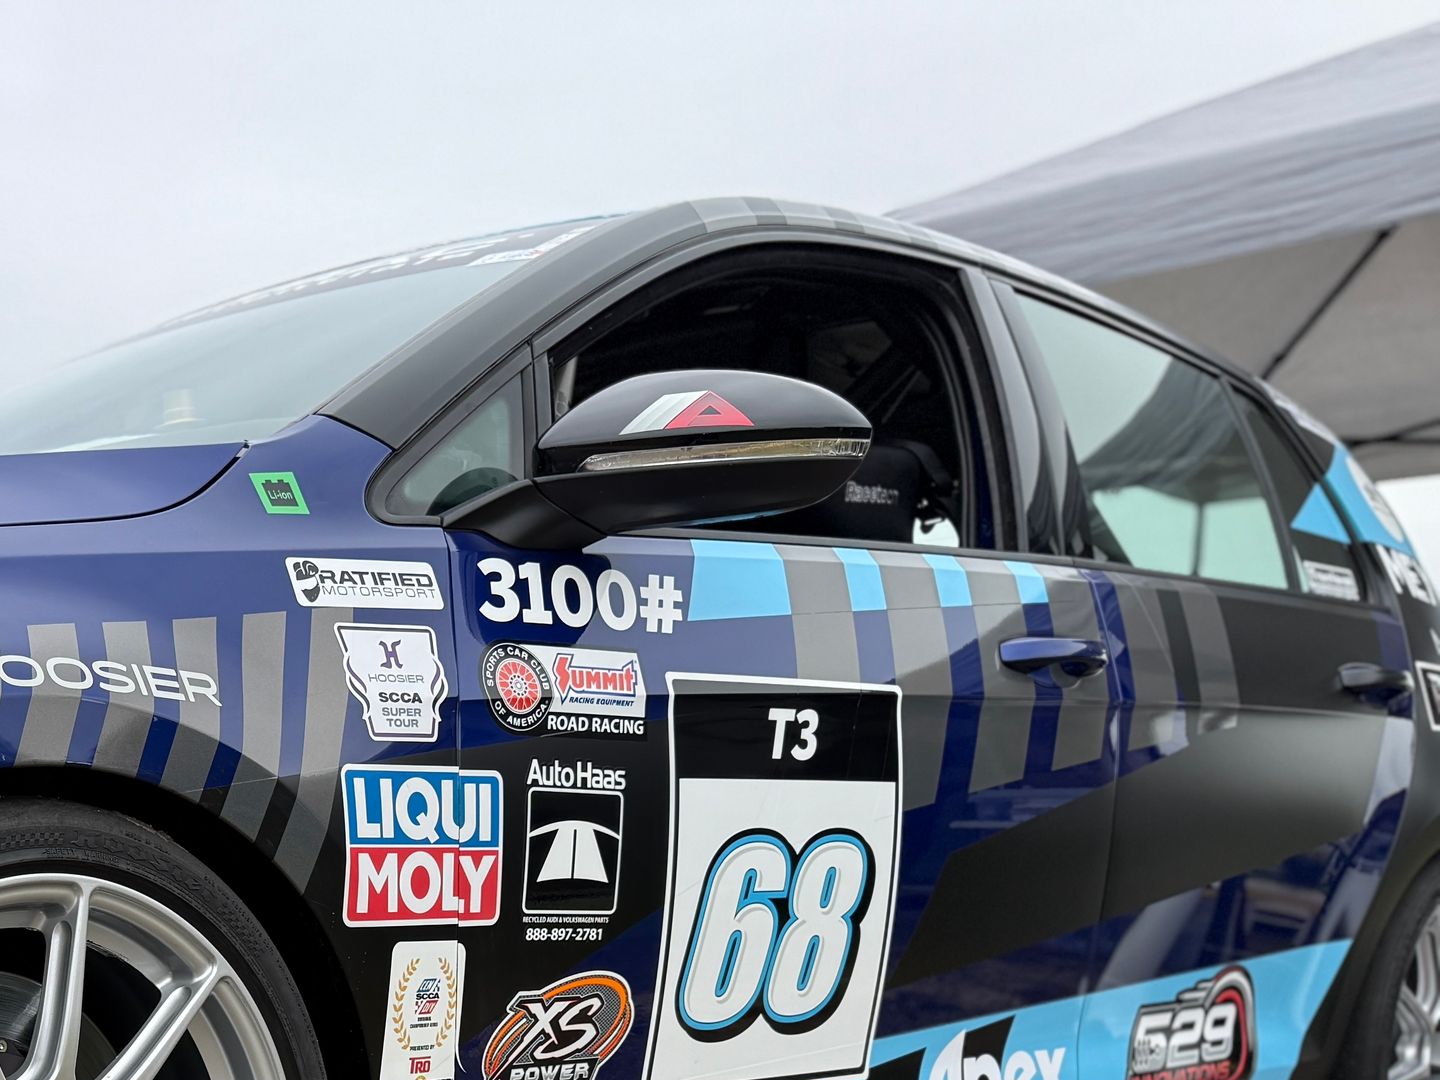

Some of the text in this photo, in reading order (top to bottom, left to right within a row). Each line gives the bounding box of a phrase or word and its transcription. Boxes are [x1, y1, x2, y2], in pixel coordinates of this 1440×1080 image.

[268, 489, 294, 500] Li-ion
[318, 570, 434, 588] RATIFIED
[322, 585, 436, 599] MOTORSPORT
[476, 557, 684, 634] 3100#
[486, 646, 551, 690] SPORTS CAR CLUB
[368, 674, 425, 684] HOOSIER
[378, 692, 423, 704] SCCA
[569, 696, 634, 707] RACING EQUIPMENT
[382, 707, 422, 718] SUPER
[494, 700, 548, 727] OF AMERICA
[386, 718, 419, 728] TOUR
[547, 714, 645, 735] ROAD RACING
[767, 707, 820, 761] T3
[352, 776, 492, 844] LIQUI
[355, 850, 497, 914] MOLY
[525, 927, 603, 941] 888-897-2781
[675, 828, 876, 1043] 68
[415, 992, 440, 1000] SCCA
[500, 997, 603, 1072] XS
[1132, 1002, 1237, 1074] 529
